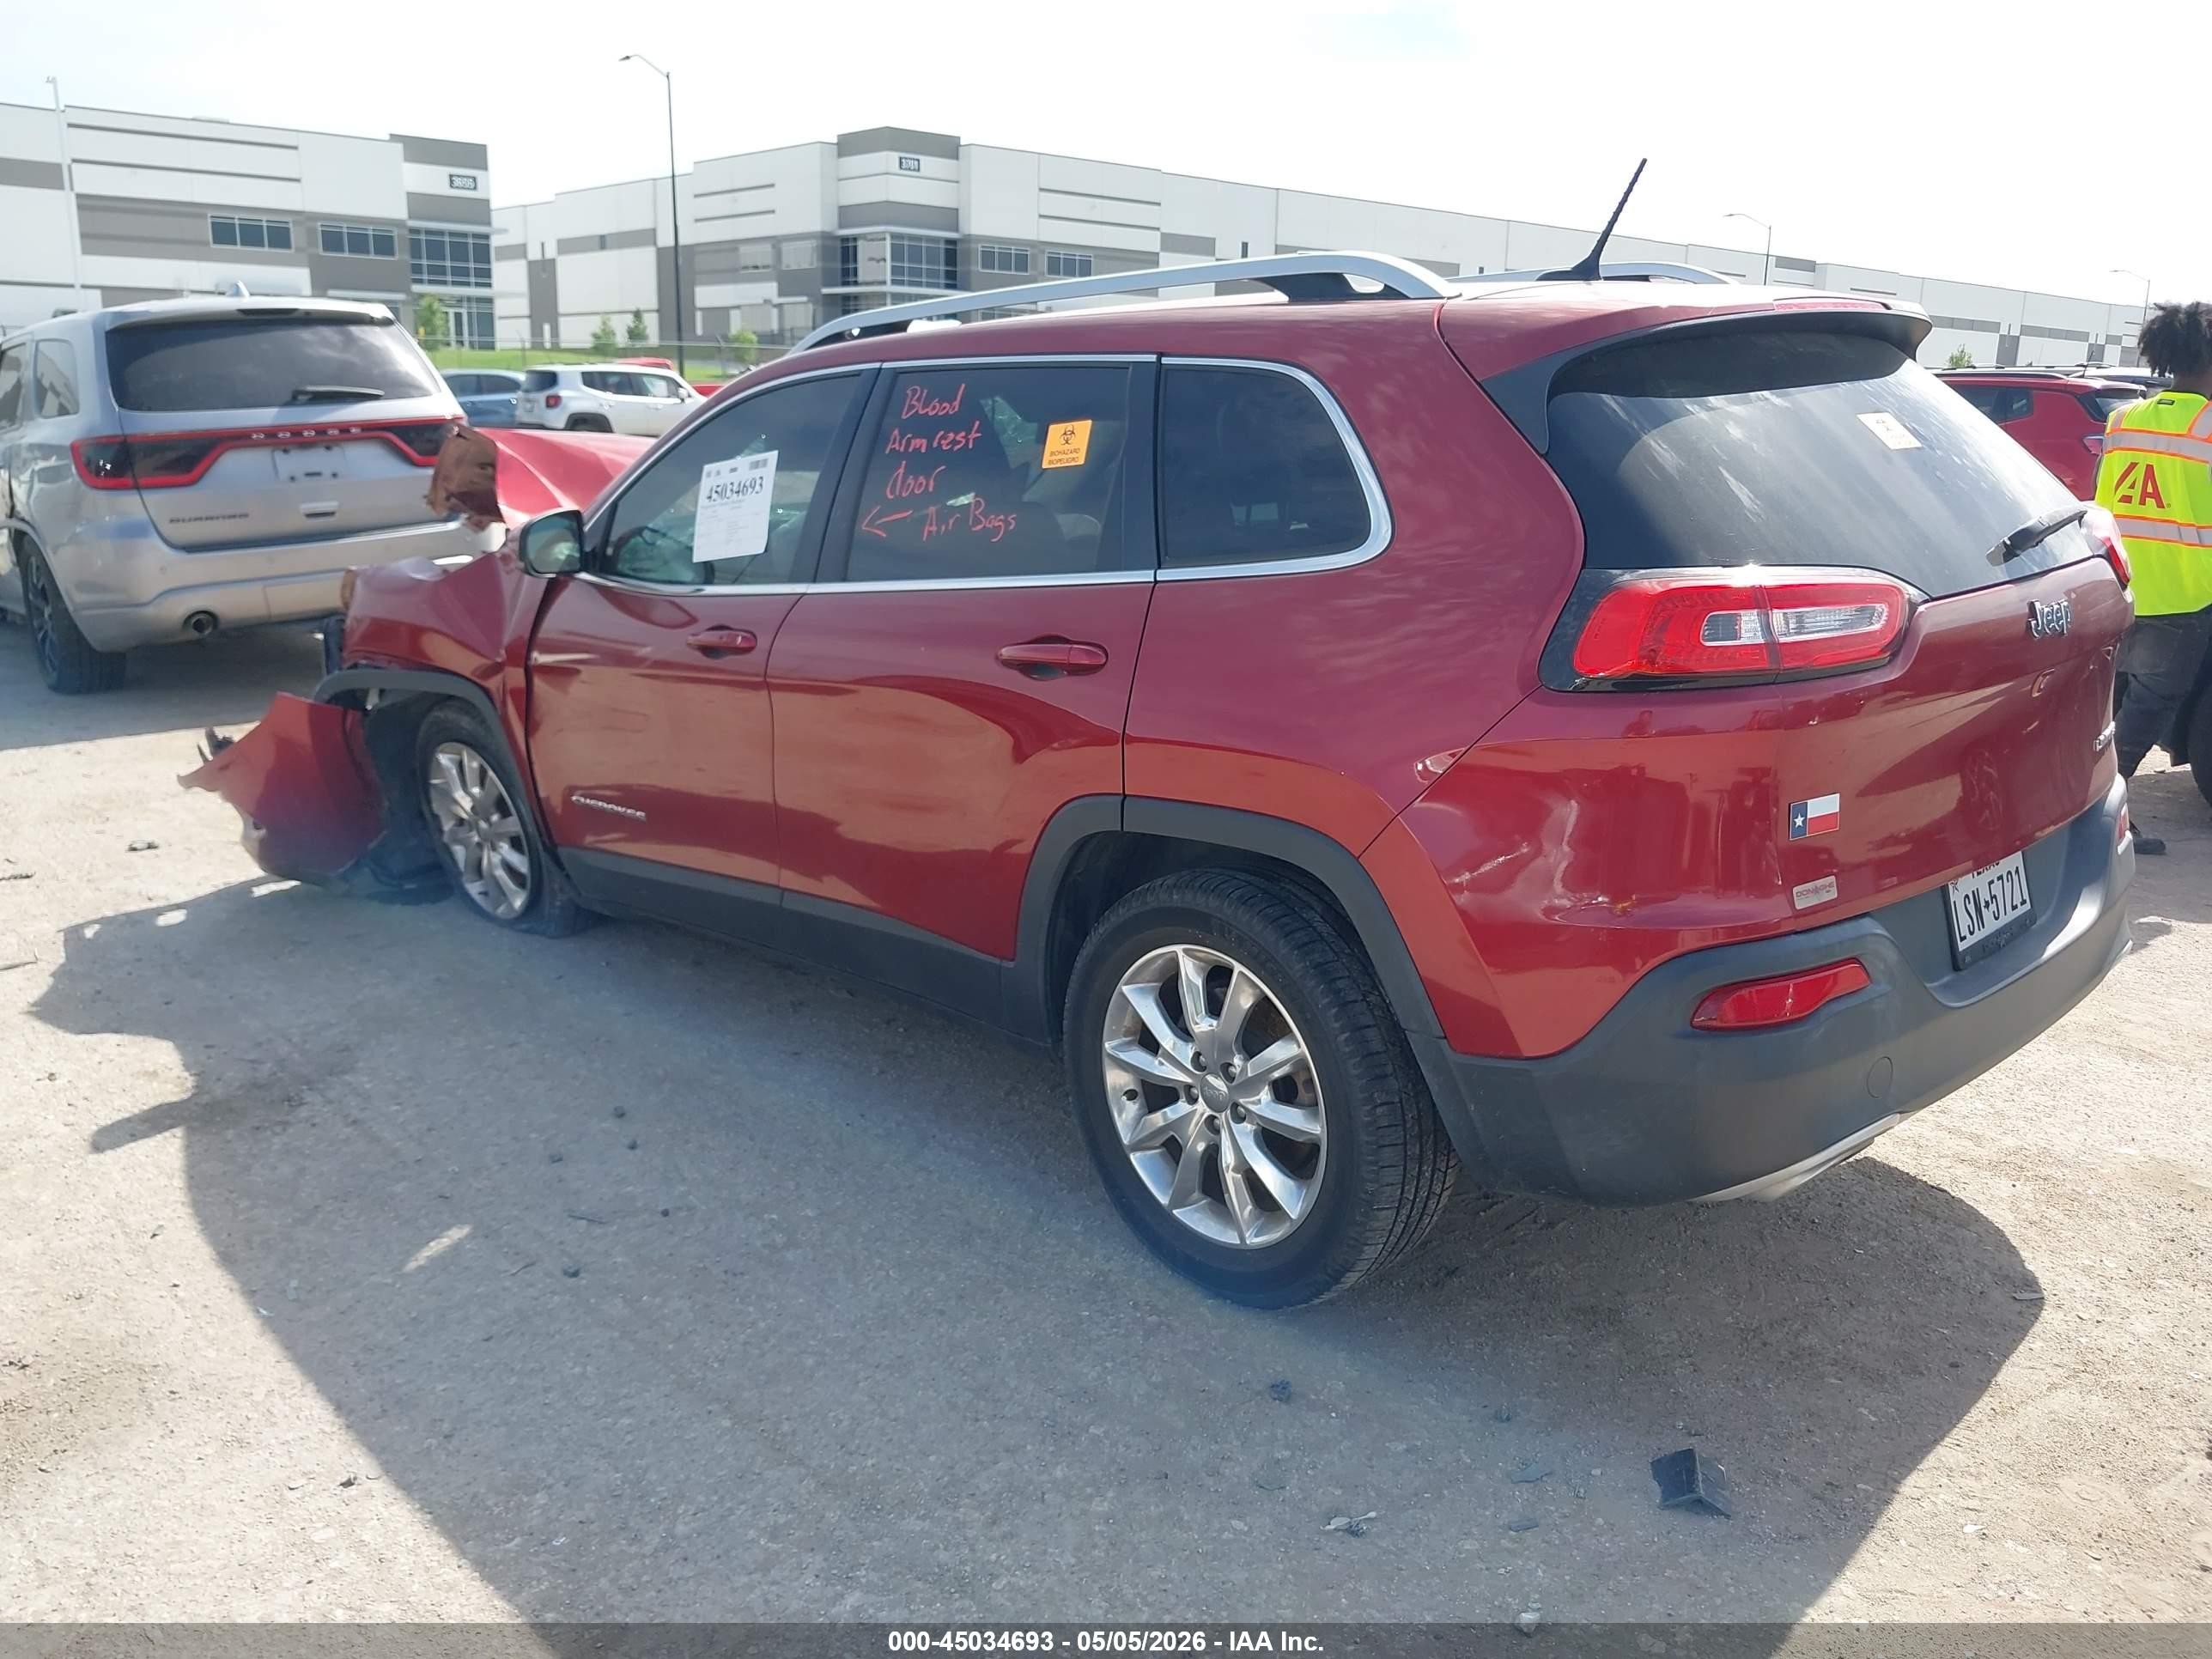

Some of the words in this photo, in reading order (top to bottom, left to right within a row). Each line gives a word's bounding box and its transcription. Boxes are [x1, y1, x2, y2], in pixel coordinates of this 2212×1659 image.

[707, 475, 764, 502] 45034693
[886, 460, 946, 499] door
[923, 506, 961, 541] Air
[969, 497, 1017, 542] Bags
[2027, 599, 2071, 638] Jeep
